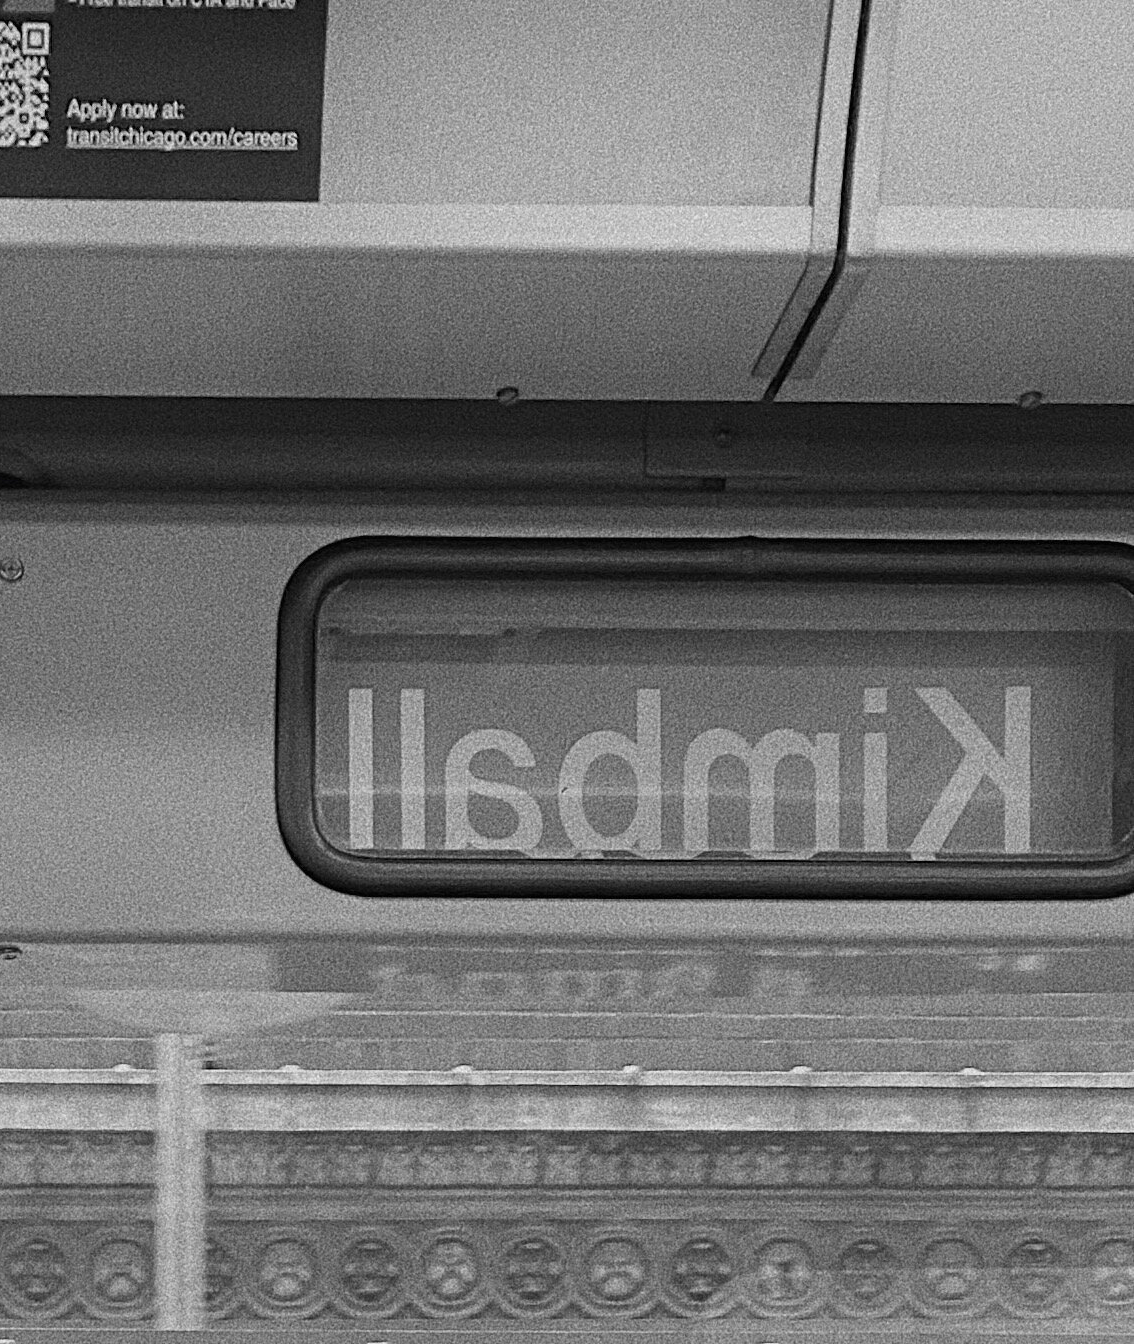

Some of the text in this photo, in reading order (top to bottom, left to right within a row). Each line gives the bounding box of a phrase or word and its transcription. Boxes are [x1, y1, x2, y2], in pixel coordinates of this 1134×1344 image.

[66, 98, 185, 123] Apply now at:
[67, 126, 299, 151] transitchicago.com/careers
